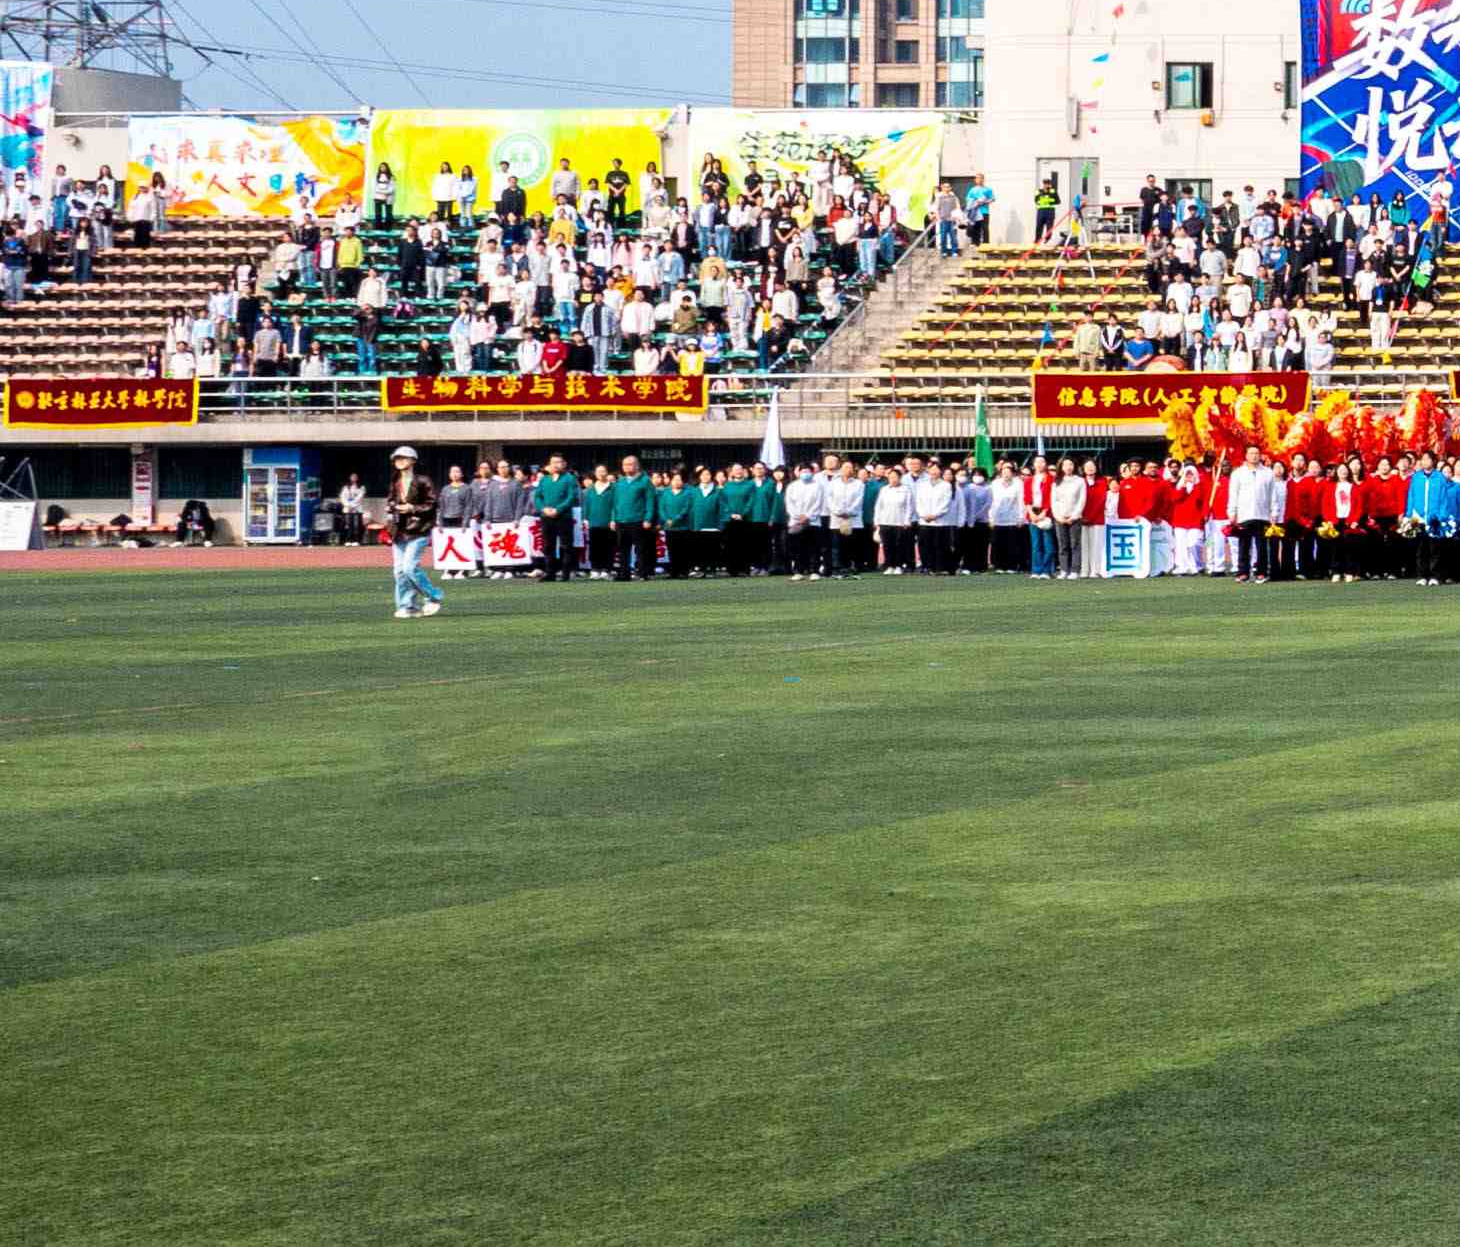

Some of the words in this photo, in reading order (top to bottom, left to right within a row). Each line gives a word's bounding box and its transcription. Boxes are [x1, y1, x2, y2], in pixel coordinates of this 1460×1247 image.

[401, 372, 693, 401] 生物科学与技术学院
[438, 536, 470, 562] 人
[489, 531, 526, 559] 魂
[1106, 524, 1143, 571] 国
